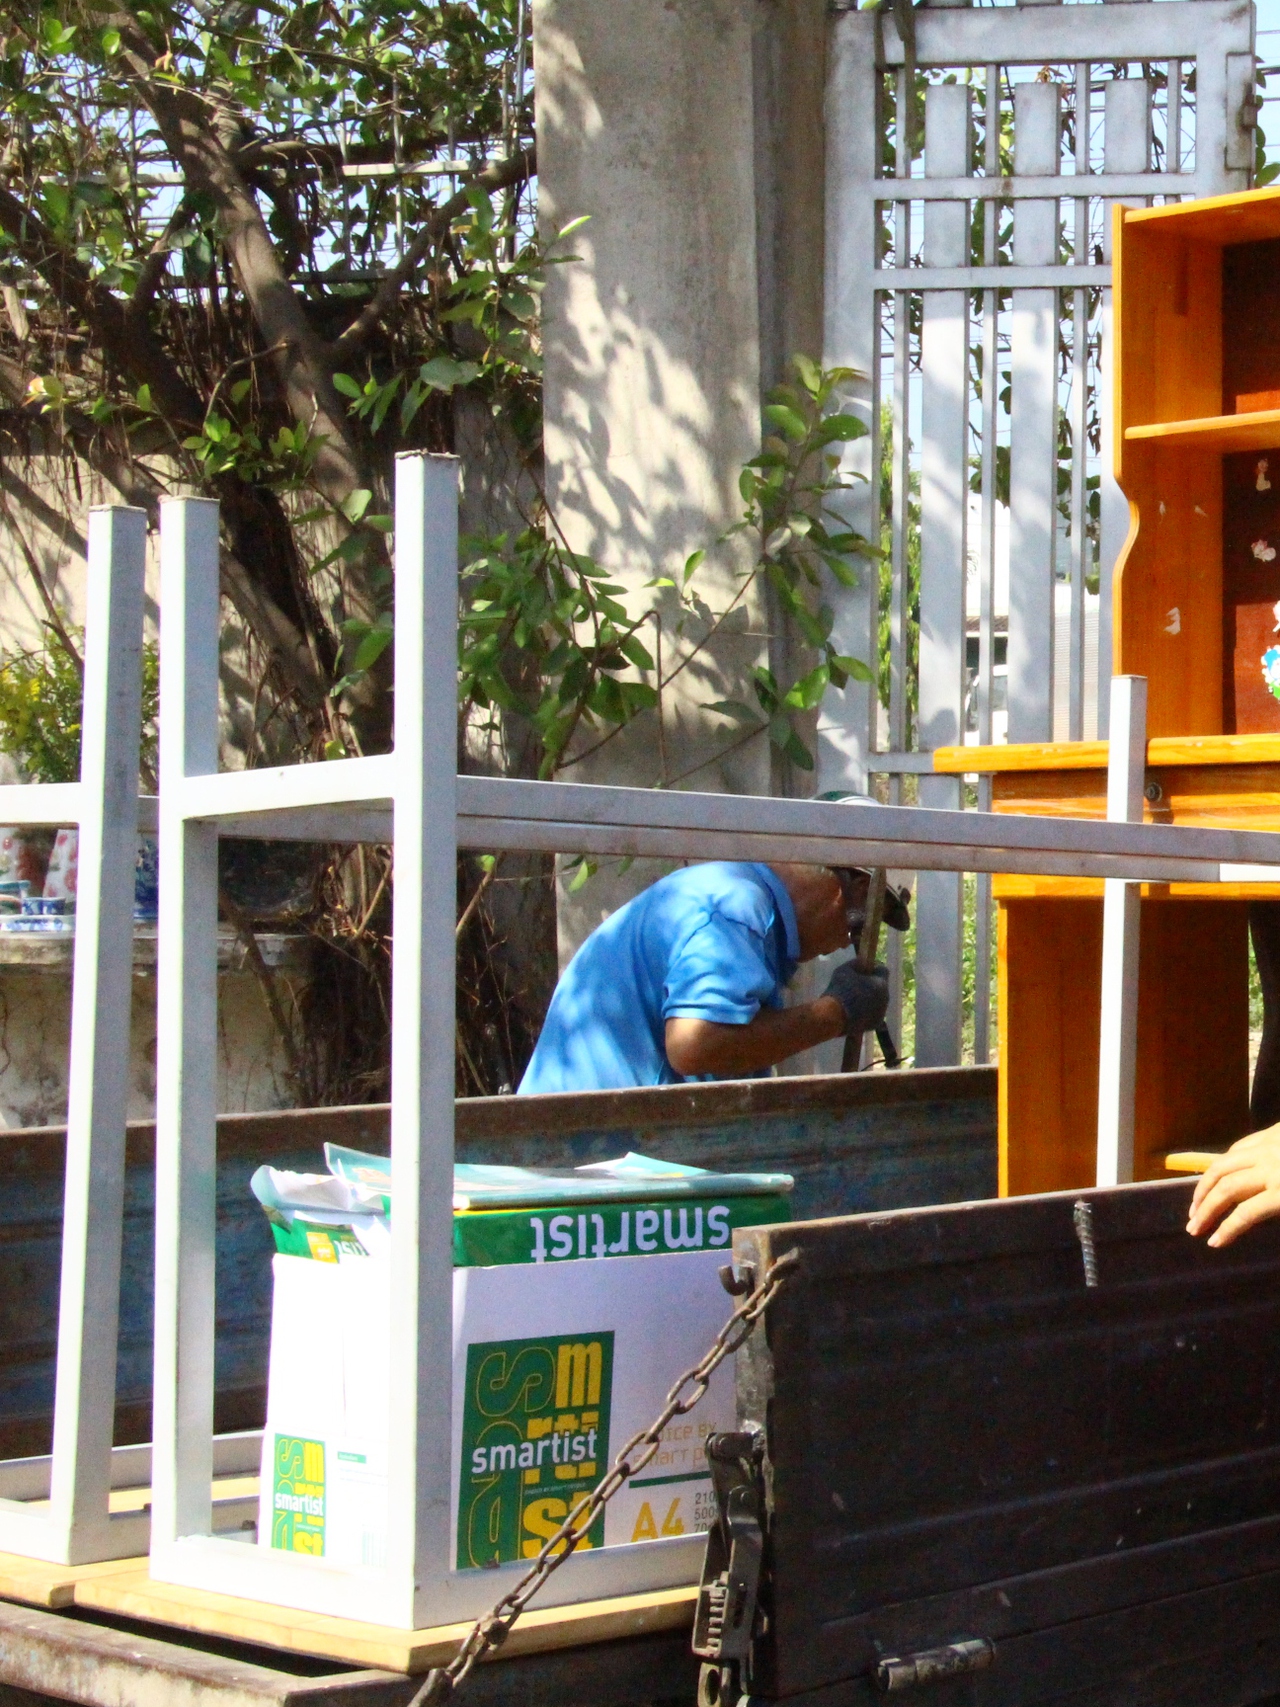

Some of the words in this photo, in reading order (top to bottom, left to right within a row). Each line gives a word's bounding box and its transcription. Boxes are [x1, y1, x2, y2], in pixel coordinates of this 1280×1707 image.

[531, 1205, 731, 1263] smartist
[471, 1428, 597, 1474] smartist
[275, 1492, 324, 1516] smartist
[631, 1497, 684, 1541] A4
